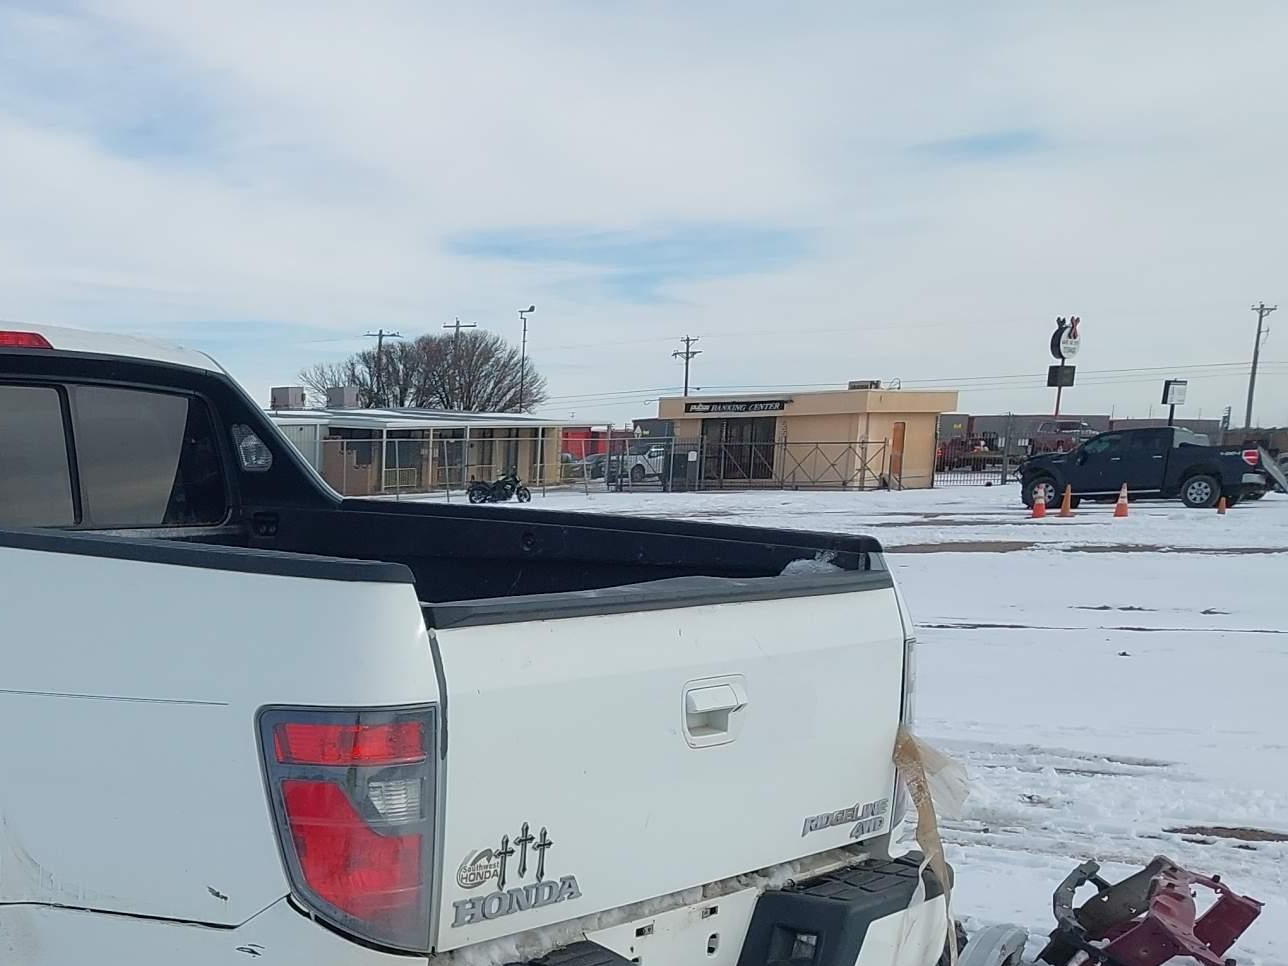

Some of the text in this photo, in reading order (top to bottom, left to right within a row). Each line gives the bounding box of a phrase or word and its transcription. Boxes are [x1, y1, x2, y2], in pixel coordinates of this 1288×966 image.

[748, 401, 781, 411] CENTER
[801, 798, 888, 838] RIDGELINE
[849, 816, 884, 839] 4WD
[460, 869, 500, 883] HONDA
[462, 861, 500, 873] Southwest
[451, 875, 582, 928] HONDA
